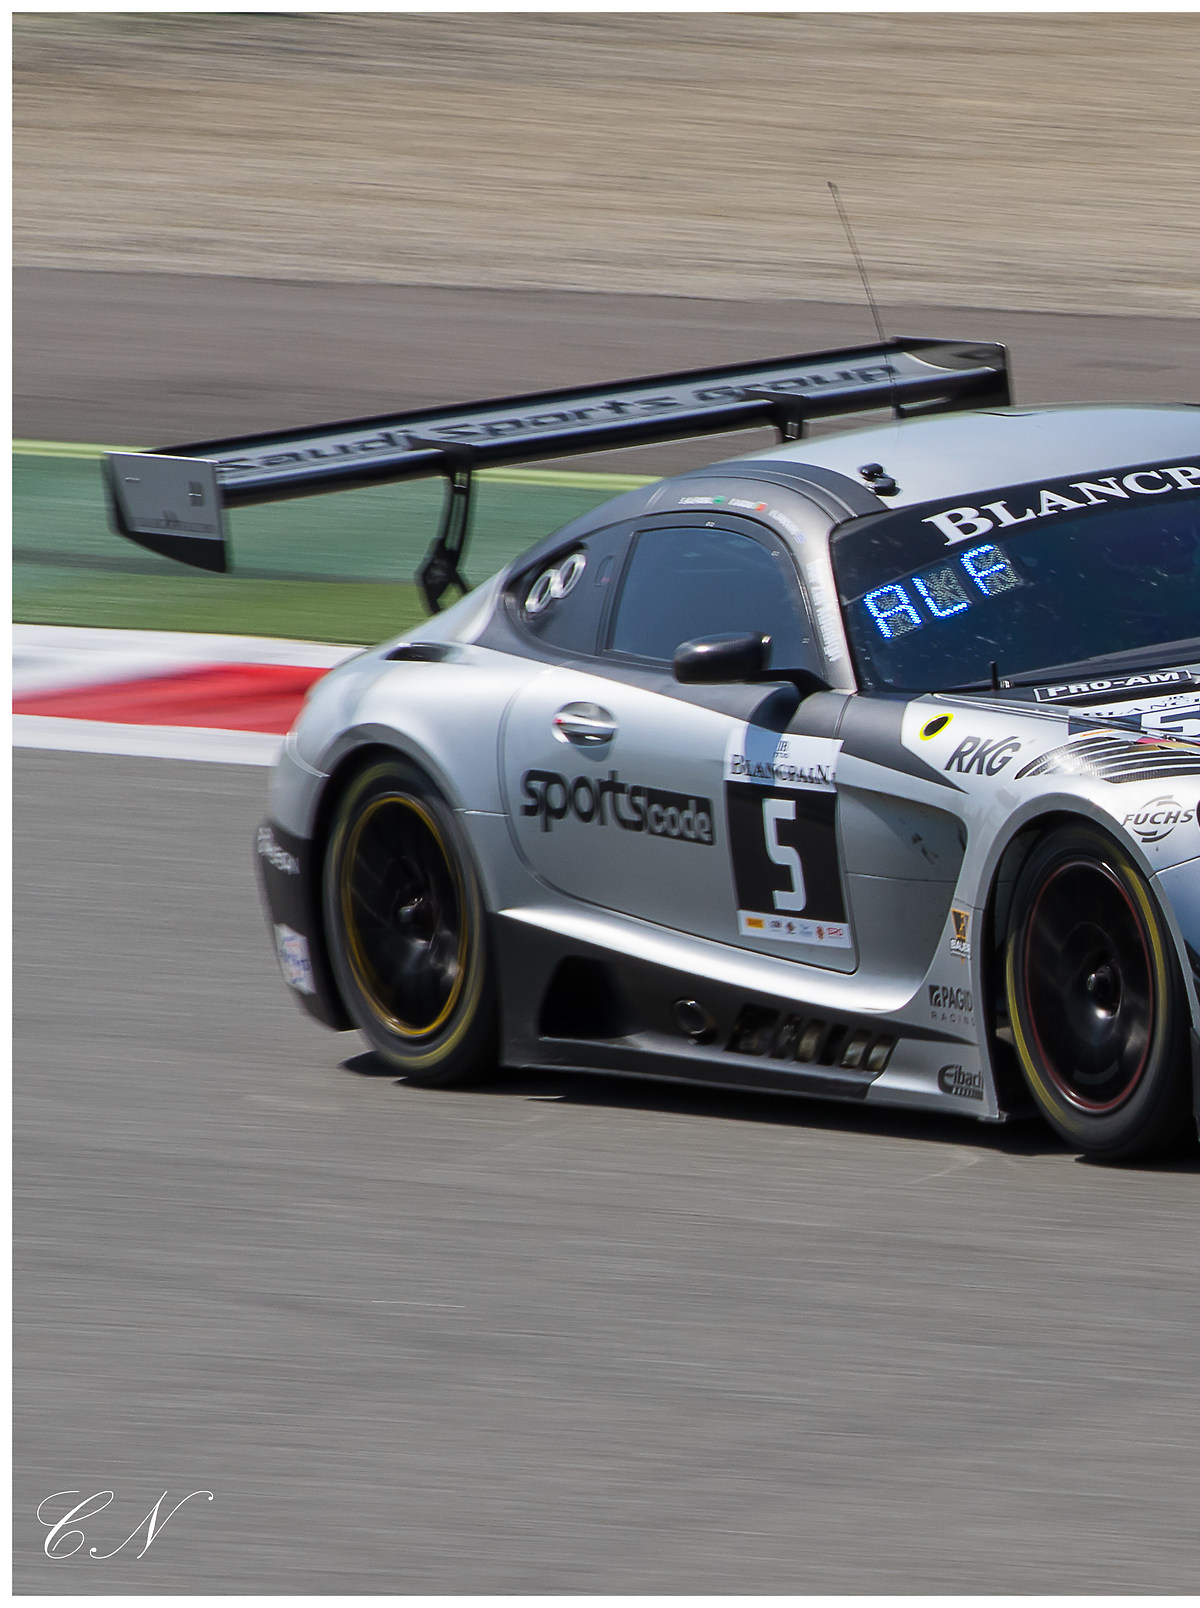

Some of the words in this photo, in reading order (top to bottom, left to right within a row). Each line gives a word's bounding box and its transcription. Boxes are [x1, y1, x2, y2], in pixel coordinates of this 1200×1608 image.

[430, 396, 677, 440] Sports
[1047, 672, 1181, 697] PRO-AM
[945, 736, 1021, 776] RKG
[1121, 808, 1196, 828] FUCHS
[763, 798, 806, 911] 5
